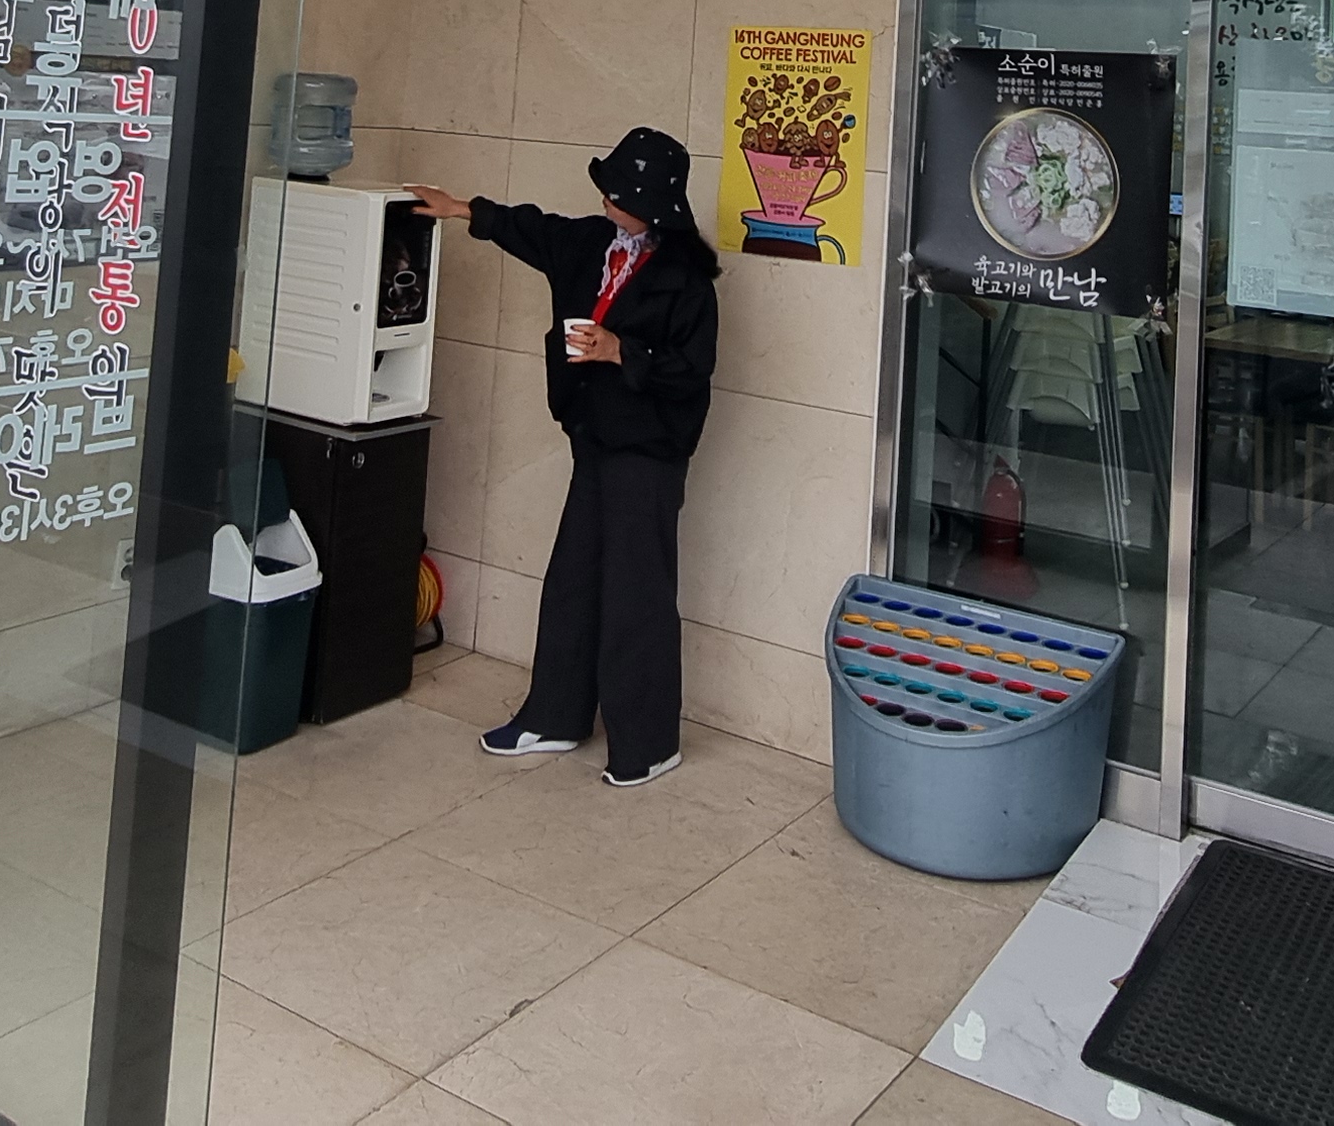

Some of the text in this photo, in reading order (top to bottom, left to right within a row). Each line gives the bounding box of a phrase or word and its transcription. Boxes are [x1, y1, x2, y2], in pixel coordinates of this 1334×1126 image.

[734, 30, 865, 48] 16TH GANGNEUNG
[740, 46, 857, 64] COFFEE FESTIVAL
[998, 53, 1055, 75] 소순이
[1039, 266, 1108, 307] 만남
